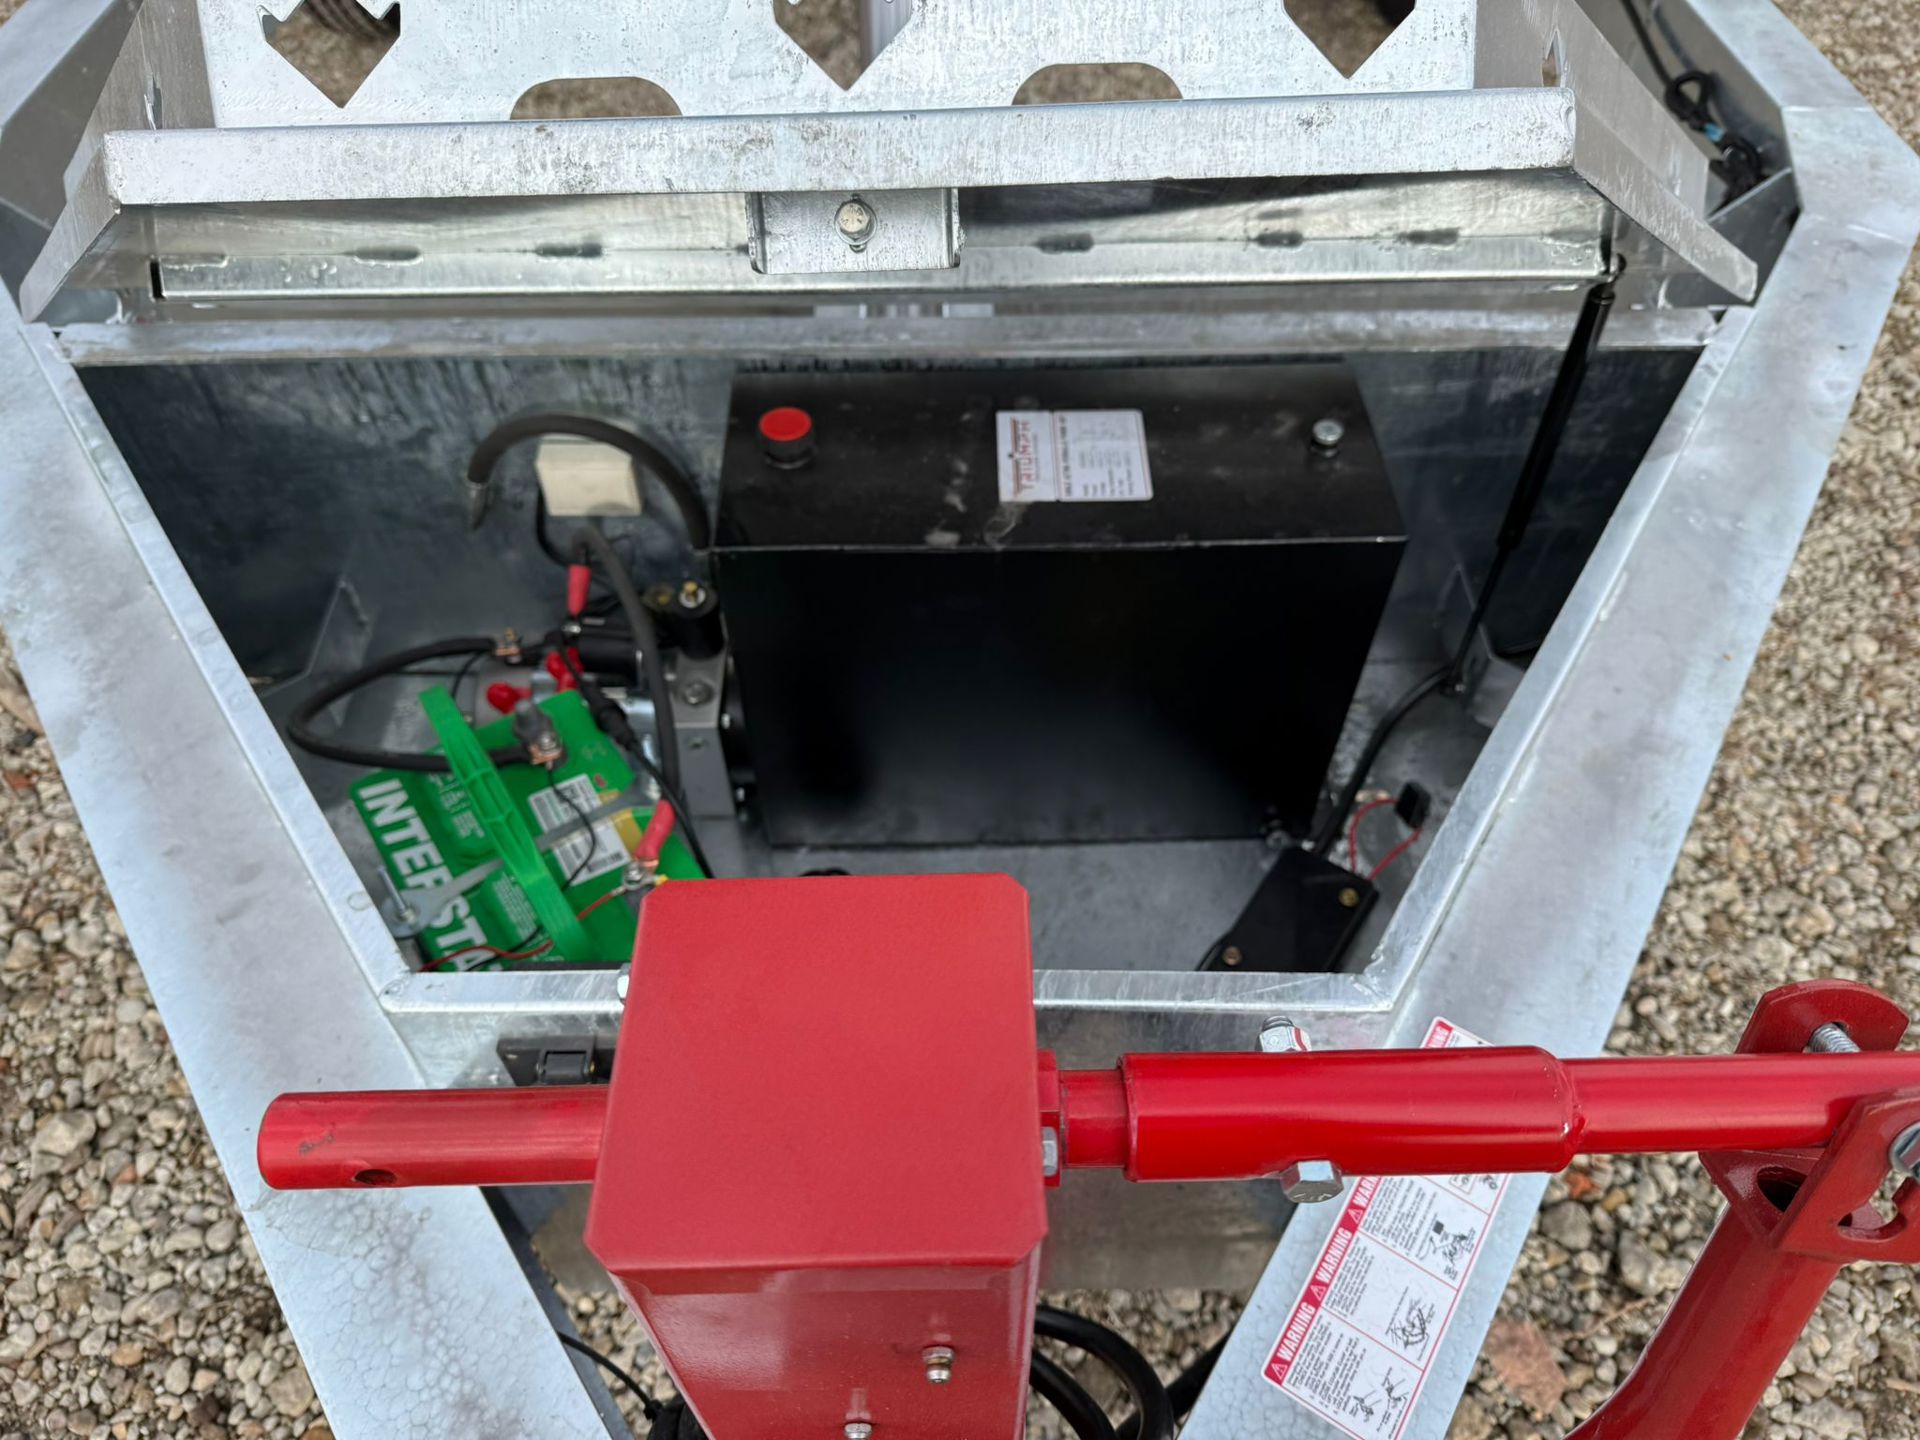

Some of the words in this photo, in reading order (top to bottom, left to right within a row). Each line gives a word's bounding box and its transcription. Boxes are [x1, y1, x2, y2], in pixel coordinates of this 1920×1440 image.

[358, 778, 503, 972] INTERSTA
[1315, 1227, 1351, 1284] WARNING
[1277, 1301, 1316, 1362] WARNING
